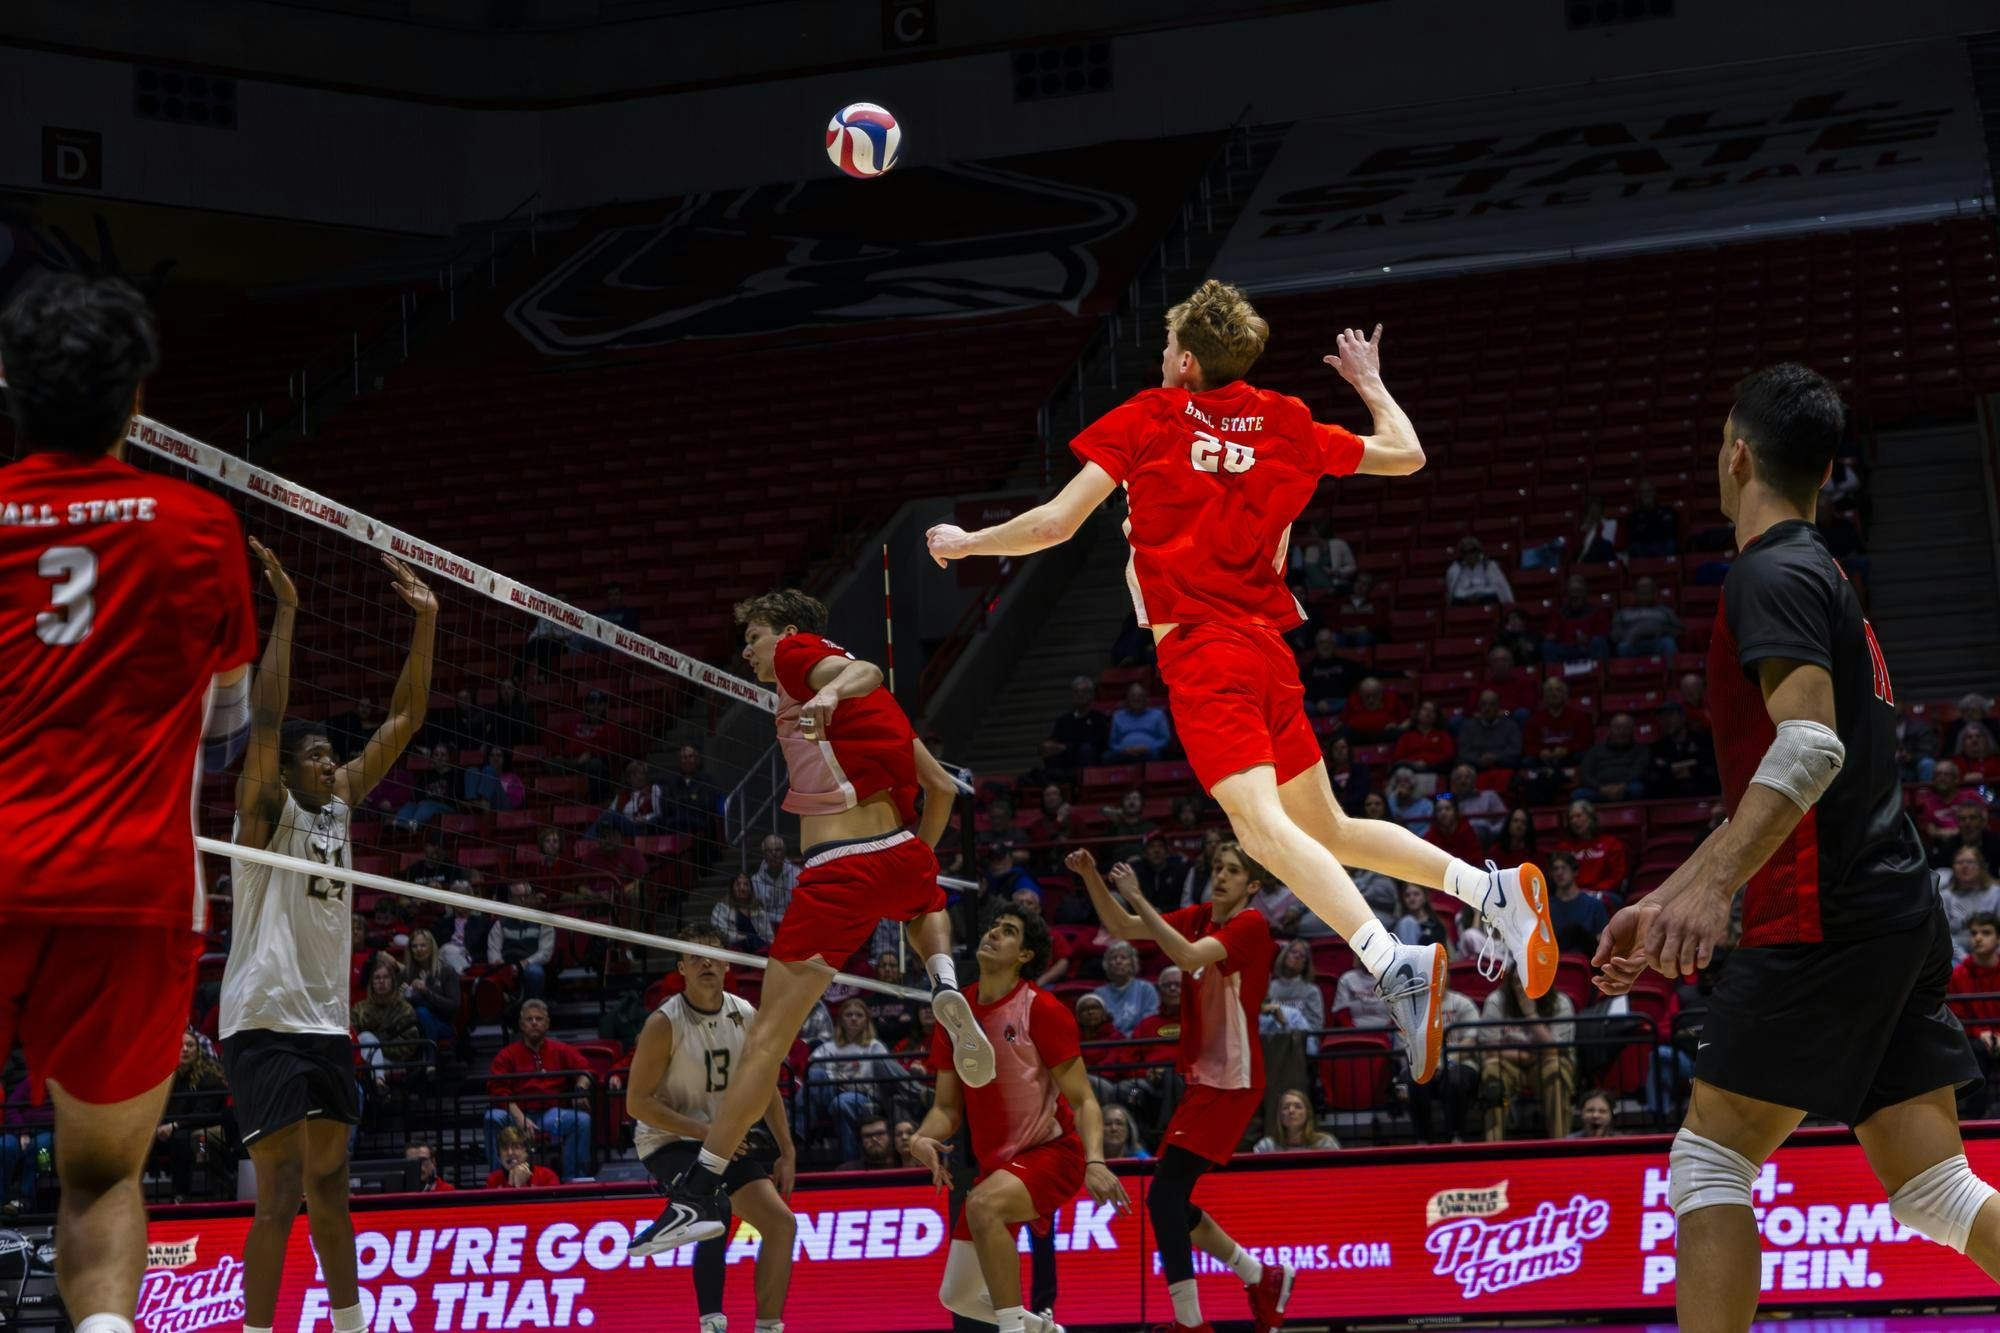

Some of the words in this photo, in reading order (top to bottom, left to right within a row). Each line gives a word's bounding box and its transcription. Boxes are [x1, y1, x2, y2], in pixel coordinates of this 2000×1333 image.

[895, 8, 924, 42] C
[1346, 91, 1898, 176] BALL
[57, 145, 87, 180] D
[1260, 108, 1952, 215] STATE
[1260, 152, 1922, 238] BASKETBALL
[140, 426, 198, 463] VOLLEYBALL
[1221, 416, 1264, 432] STATE
[0, 501, 60, 526] ALL
[67, 496, 158, 525] STATE
[247, 474, 270, 495] BALL
[271, 484, 299, 509] STATE
[299, 495, 348, 530] VOLLEYBALL
[391, 536, 409, 557] BALL
[410, 544, 433, 567] STATE
[434, 553, 475, 584] VOLLEYBALL
[36, 545, 98, 646] 3
[705, 1049, 729, 1092] 13
[1437, 1190, 1499, 1206] FARMER
[1440, 1201, 1497, 1216] OWNED
[1643, 1163, 1794, 1208] HH-
[148, 1244, 189, 1255] ARMER
[310, 1224, 527, 1281] OU'RE
[793, 1207, 945, 1262] NEED
[1425, 1194, 1610, 1275] Prairie
[148, 1255, 188, 1266] WNED
[1454, 1241, 1583, 1299] Farms
[134, 1255, 245, 1320] Prair
[432, 1277, 596, 1331] THAT.
